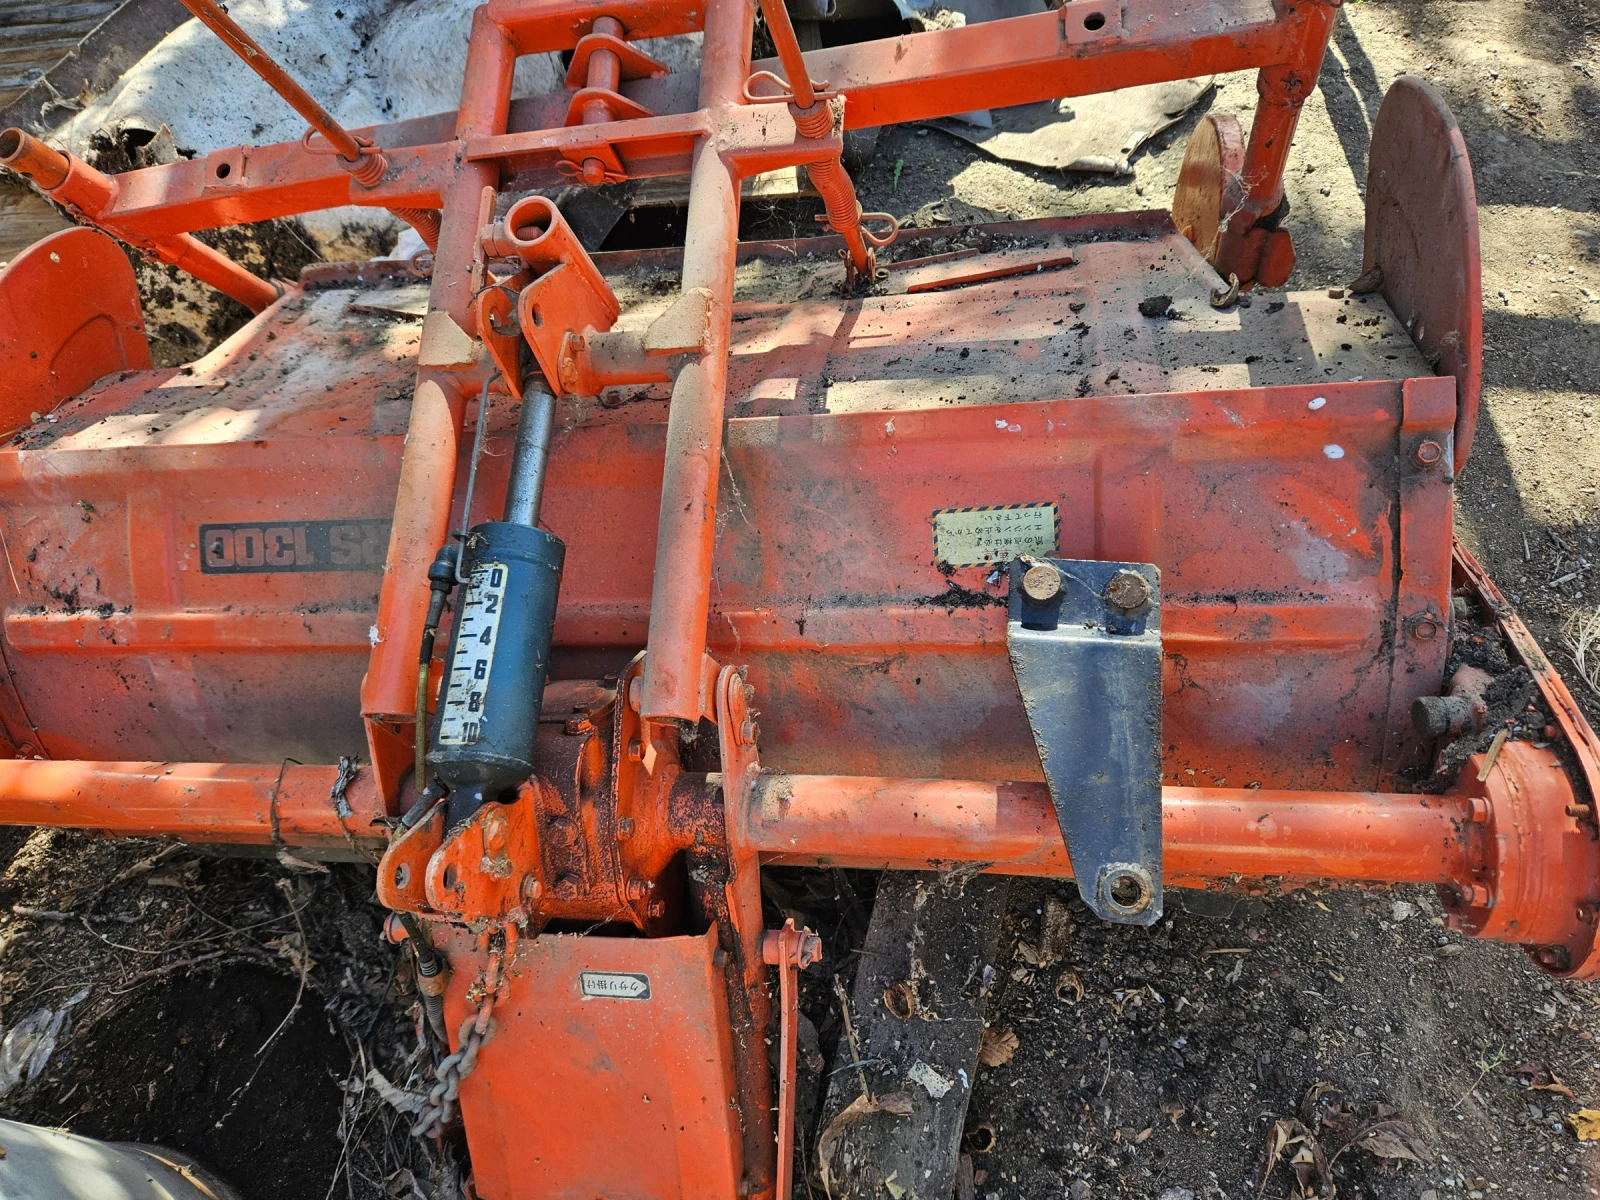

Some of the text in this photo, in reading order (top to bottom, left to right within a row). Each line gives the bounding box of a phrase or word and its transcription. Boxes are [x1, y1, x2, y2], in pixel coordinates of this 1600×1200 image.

[980, 511, 1043, 520] 行って下さい。
[946, 524, 1042, 537] エンジンを止めてから
[205, 527, 314, 567] 1300
[489, 568, 504, 588] 0
[484, 594, 499, 614] 2
[479, 626, 492, 646] 4
[473, 659, 488, 680] 6
[468, 691, 482, 713] 8
[462, 721, 479, 743] 10
[586, 980, 638, 991] クサリ掛け
